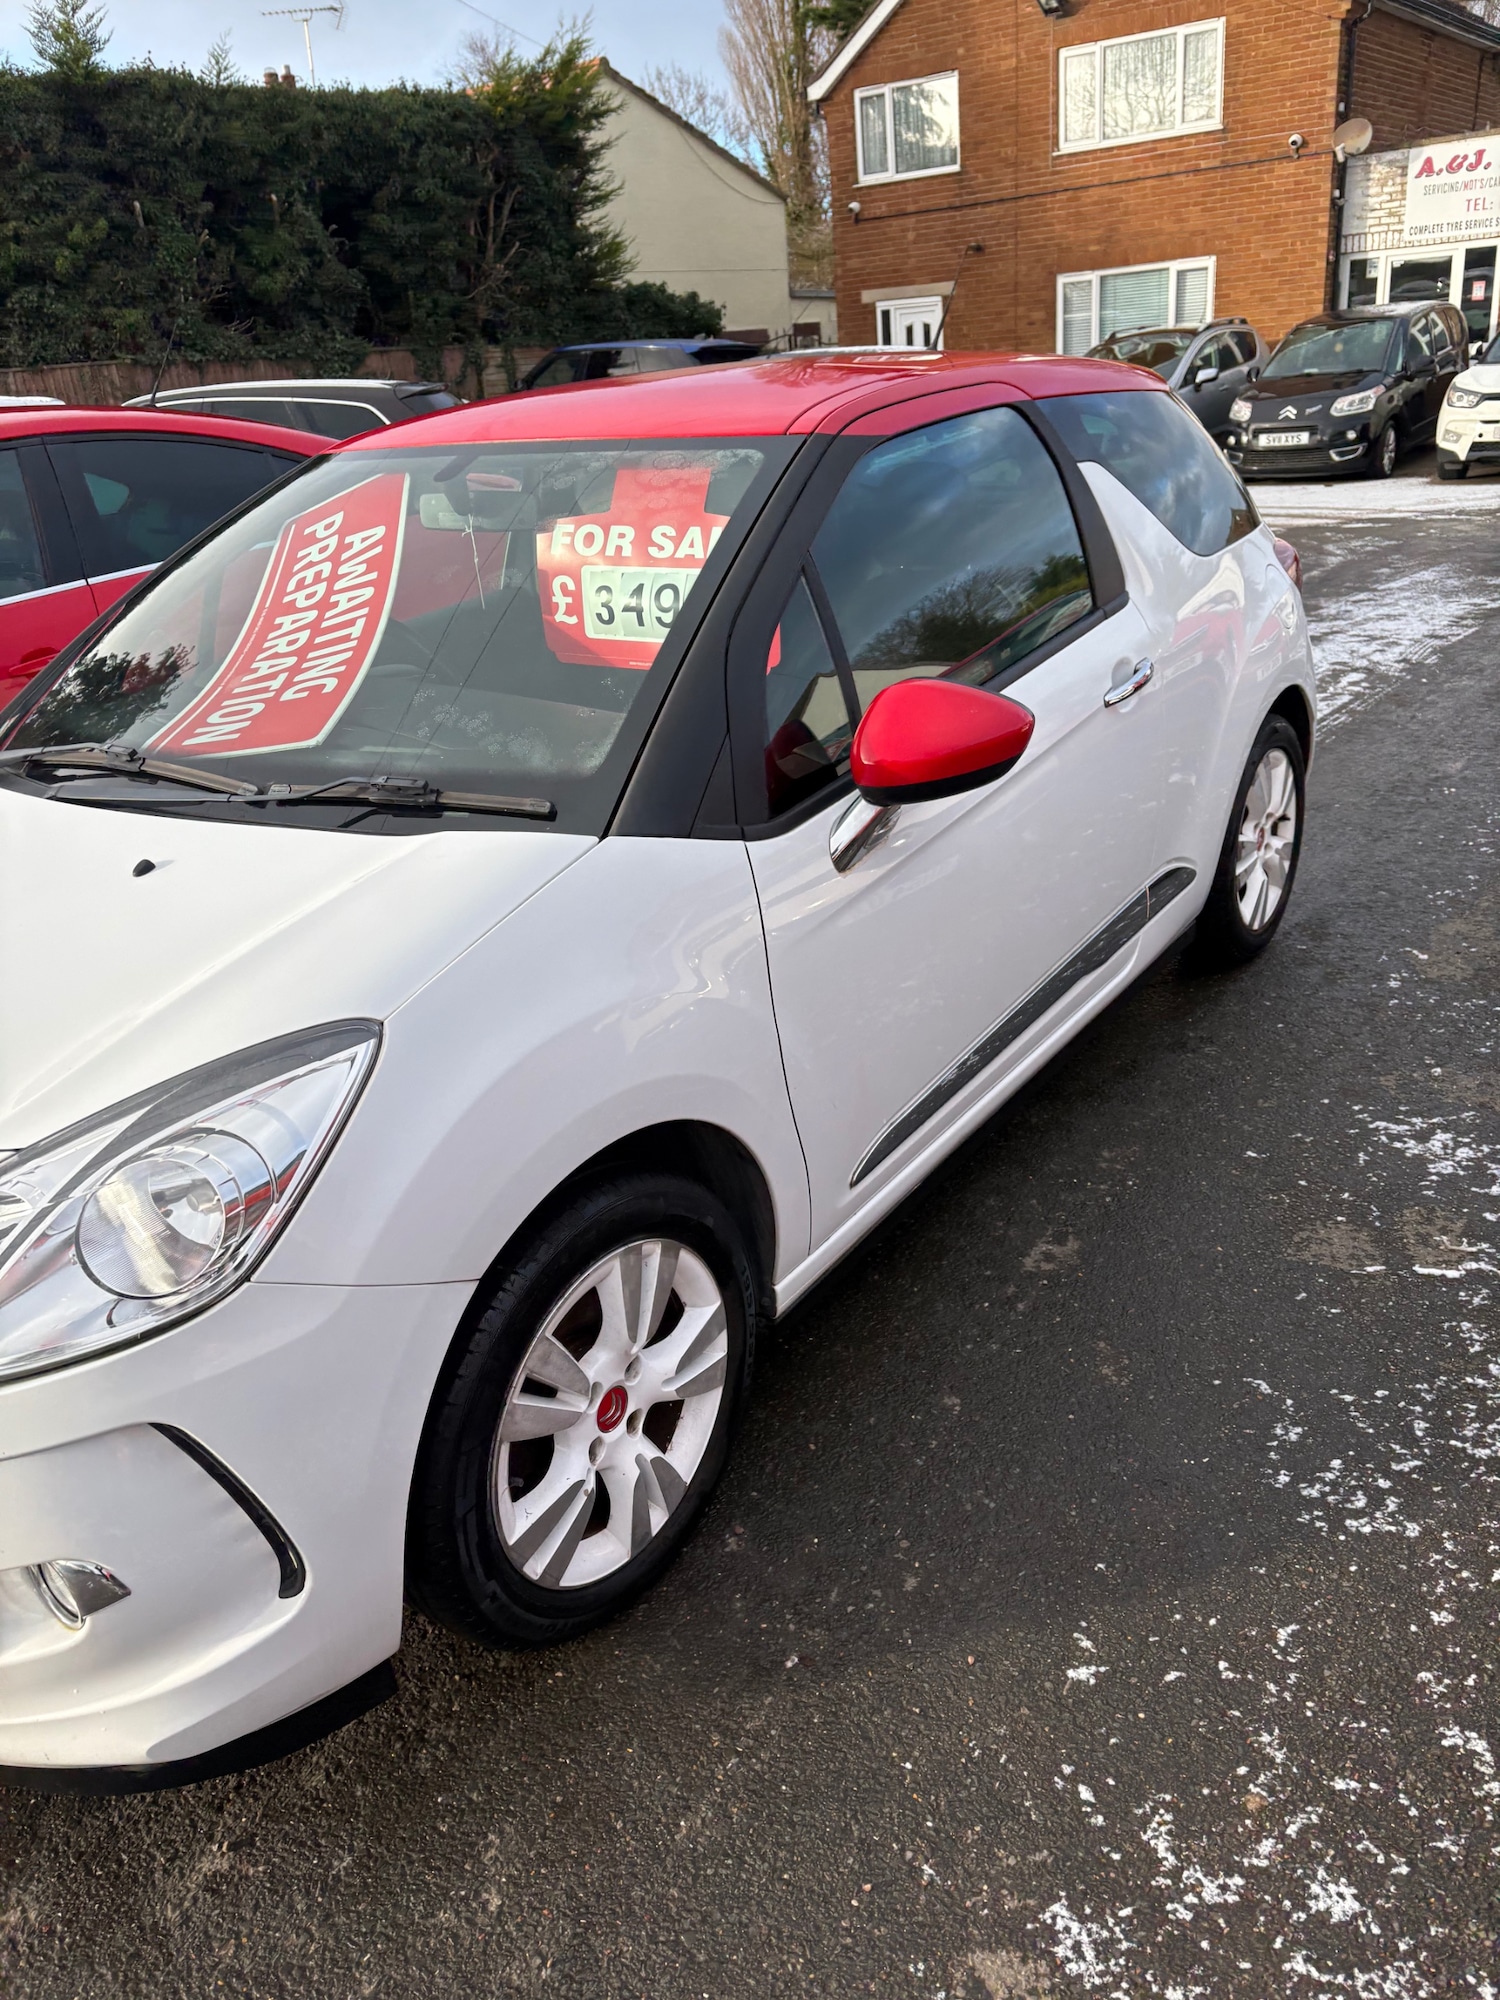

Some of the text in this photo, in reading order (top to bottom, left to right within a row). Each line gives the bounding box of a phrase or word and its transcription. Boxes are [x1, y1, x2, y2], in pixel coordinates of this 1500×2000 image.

[1465, 197, 1494, 212] TEL:
[1409, 223, 1444, 236] COMPLETE
[1446, 220, 1463, 232] TYRE
[1465, 217, 1494, 230] SERVICE
[550, 524, 635, 557] FOR
[280, 525, 386, 702] AWAITING
[552, 575, 681, 629] £ 349
[181, 511, 344, 746] PREPARATION
